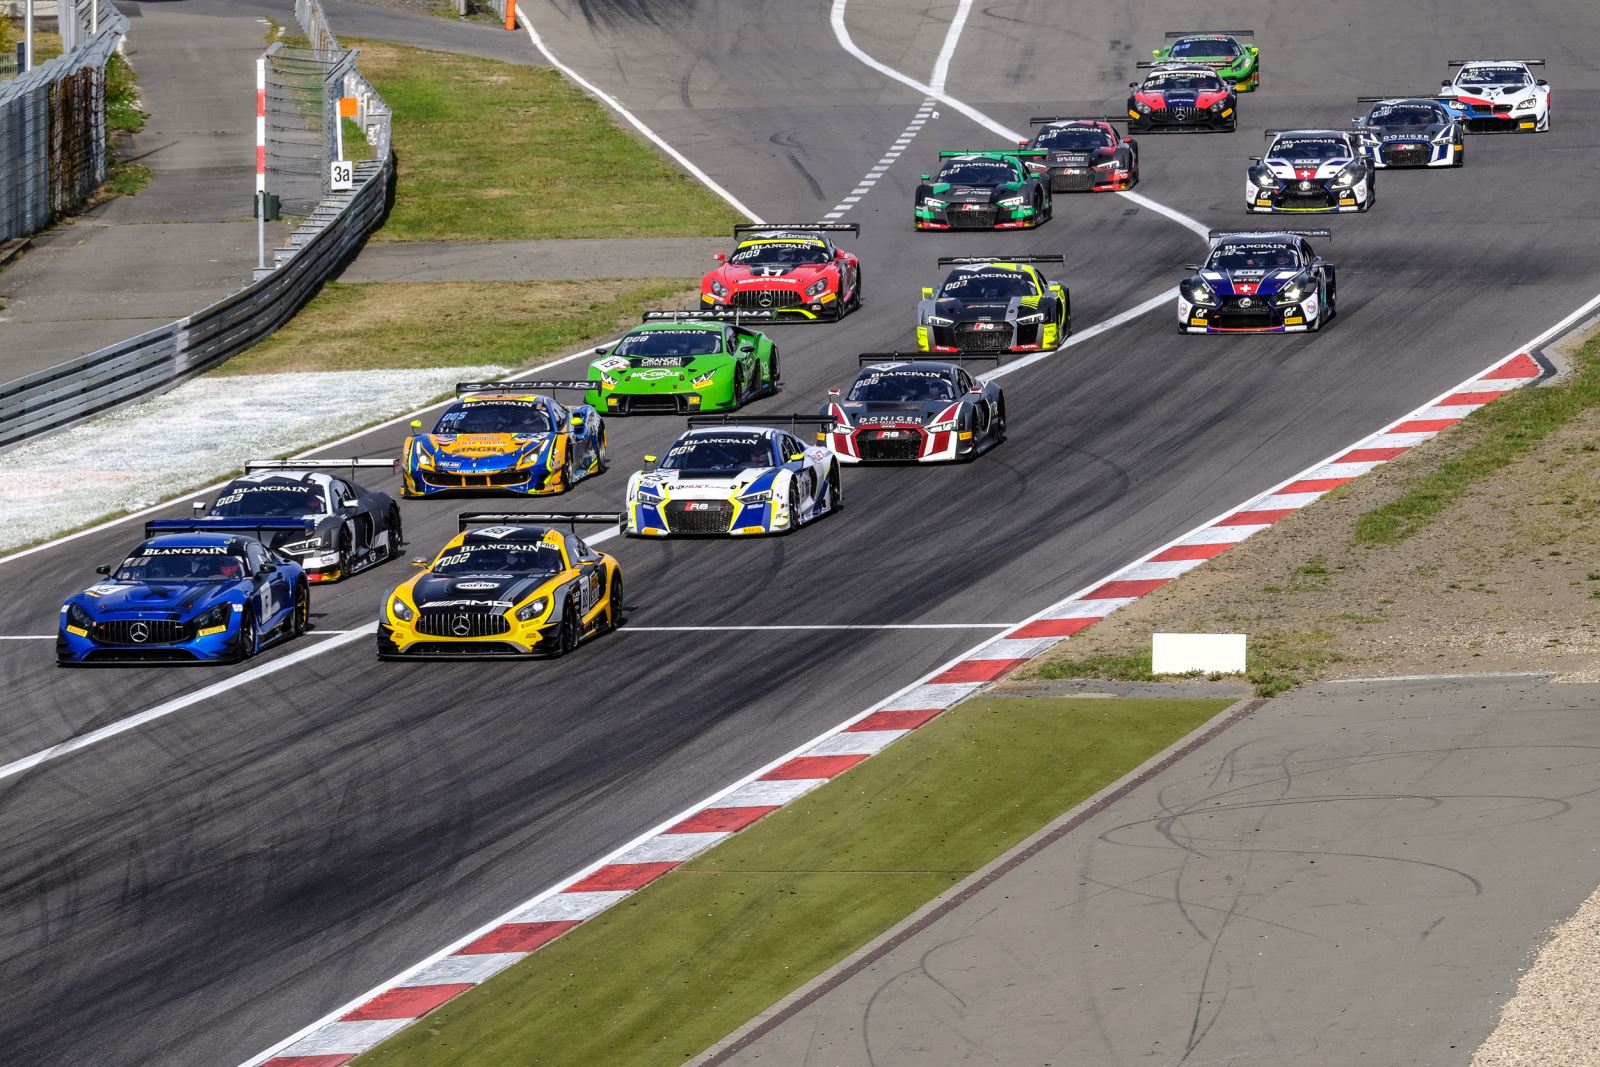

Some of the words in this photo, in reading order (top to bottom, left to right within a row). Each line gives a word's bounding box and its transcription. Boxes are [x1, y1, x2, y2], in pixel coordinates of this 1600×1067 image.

[334, 166, 350, 183] 3a
[958, 273, 1023, 281] BLANCPAIN
[871, 371, 941, 379] BLANCPAIN
[465, 381, 597, 390] SANTIBURI
[461, 399, 535, 409] BLANCPAIN
[859, 415, 922, 423] DONIGER
[683, 437, 759, 447] BLANCPAIN
[452, 446, 506, 456] SINGHA
[231, 485, 310, 495] BLANCPAIN
[215, 493, 244, 507] 003
[689, 502, 709, 511] R8
[142, 547, 229, 557] BLANCPAIN
[460, 543, 540, 554] BLANCPAIN
[440, 552, 471, 567] 002
